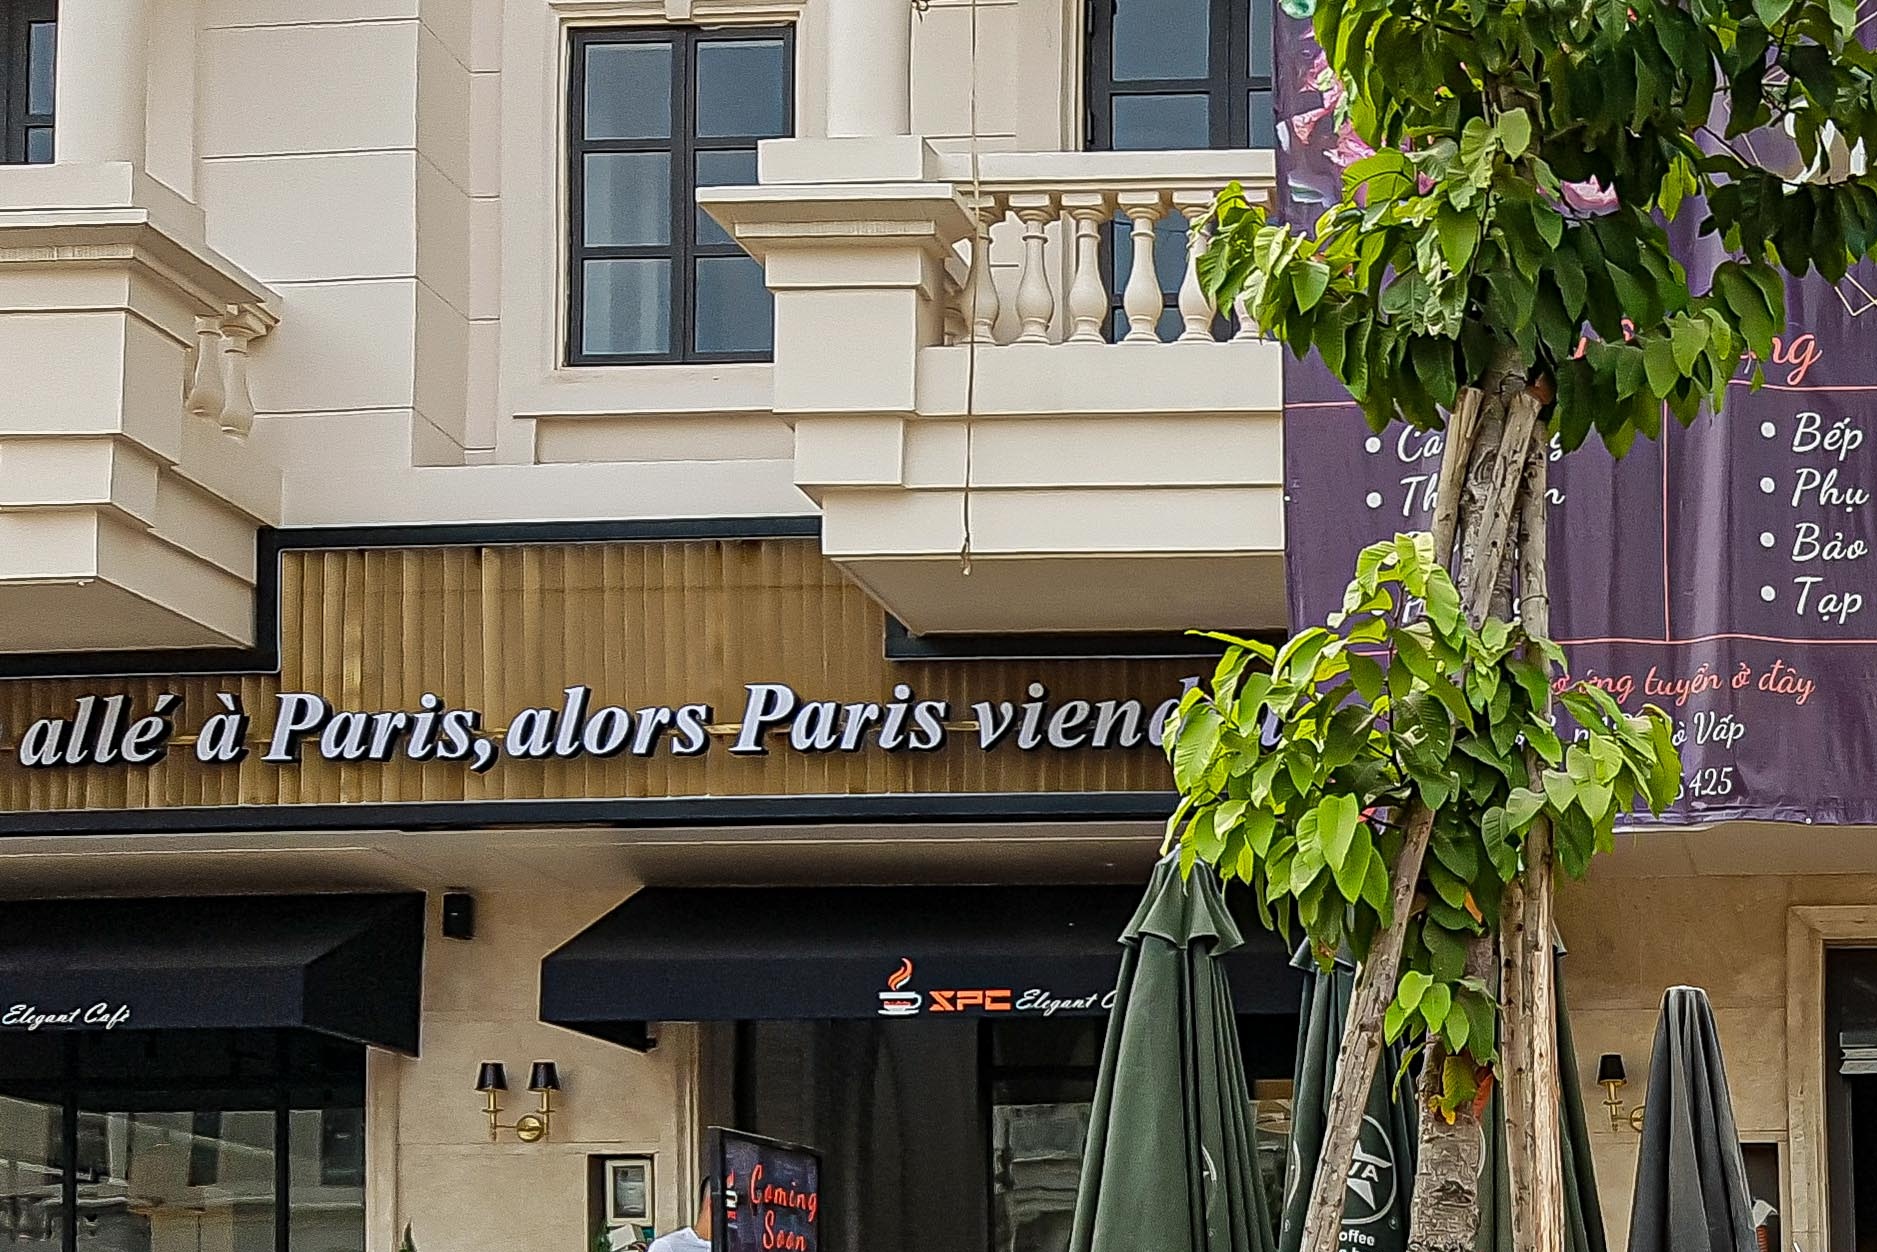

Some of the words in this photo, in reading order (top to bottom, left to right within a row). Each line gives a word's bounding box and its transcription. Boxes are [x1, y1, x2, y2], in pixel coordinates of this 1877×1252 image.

[1792, 411, 1863, 461] Bếp
[1791, 468, 1870, 513] Phụ
[1791, 523, 1869, 562] Bảo
[1794, 576, 1862, 624] Tạp
[1644, 663, 1723, 706] tuyển
[1732, 661, 1752, 688] ở
[1758, 659, 1816, 705] đây
[20, 692, 182, 766] allé
[196, 690, 242, 762] à
[261, 691, 495, 771] Paris,
[506, 684, 708, 758] alors
[728, 683, 949, 754] Paris
[1693, 711, 1745, 750] Vấp
[1688, 766, 1733, 798] 425
[1, 1003, 82, 1031] Elegant
[1015, 988, 1100, 1018] Elegant
[750, 1163, 817, 1223] Coming
[762, 1209, 806, 1252] Soon
[1338, 1228, 1376, 1247] offee
